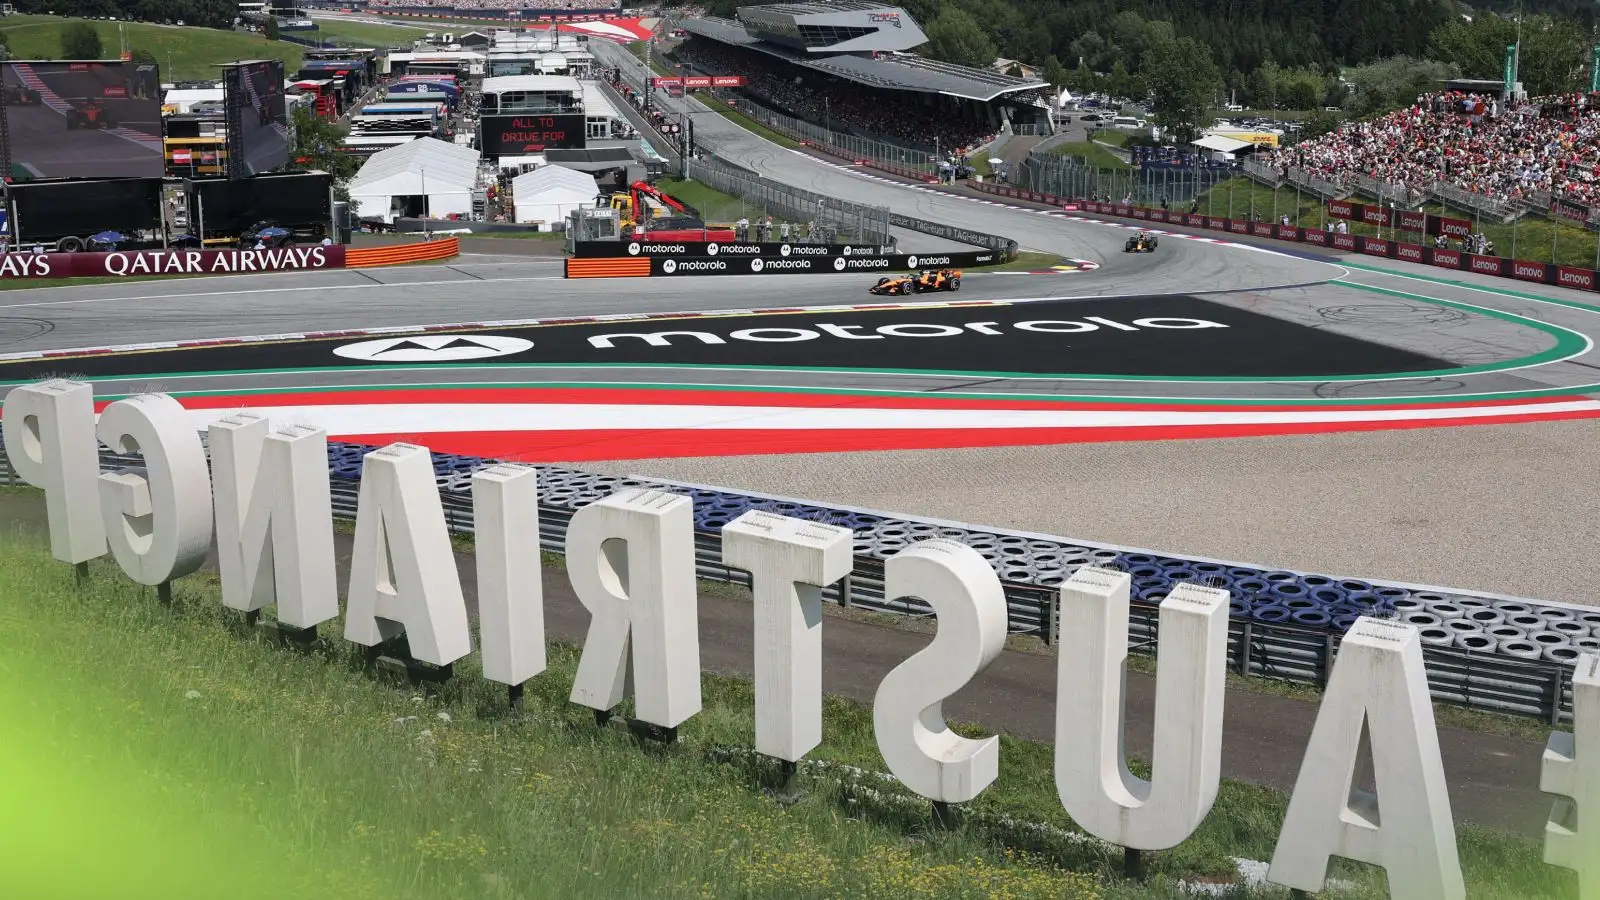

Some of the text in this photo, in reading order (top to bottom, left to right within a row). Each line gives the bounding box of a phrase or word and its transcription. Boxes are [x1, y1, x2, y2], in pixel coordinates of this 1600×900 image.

[512, 117, 554, 128] ALL TO
[502, 130, 565, 142] DRIVE FOR
[1329, 202, 1351, 216] Lenovo
[1364, 209, 1387, 222] Lenovo
[1231, 220, 1246, 232] Lenovo
[1401, 215, 1425, 229] Lenovo
[1441, 220, 1469, 236] Lenovo
[1279, 226, 1297, 238] Lenovo
[1305, 231, 1325, 243] Lenovo
[1334, 235, 1354, 247] Lenovo
[1365, 241, 1387, 253] Lenovo
[642, 244, 686, 253] motorola
[720, 244, 761, 254] motorola
[792, 246, 828, 255] motorola
[1398, 245, 1421, 259] Lenovo
[104, 247, 326, 276] QATAR AIRWAYS
[679, 258, 727, 270] motorola
[765, 259, 811, 269] motorola
[848, 258, 889, 268] motorola
[919, 256, 950, 266] motorola
[1434, 251, 1458, 265] Lenovo
[1472, 256, 1498, 272] Lenovo
[1514, 263, 1543, 278] Lenovo
[1560, 269, 1591, 286] Lenovo
[588, 316, 1229, 348] motorola
